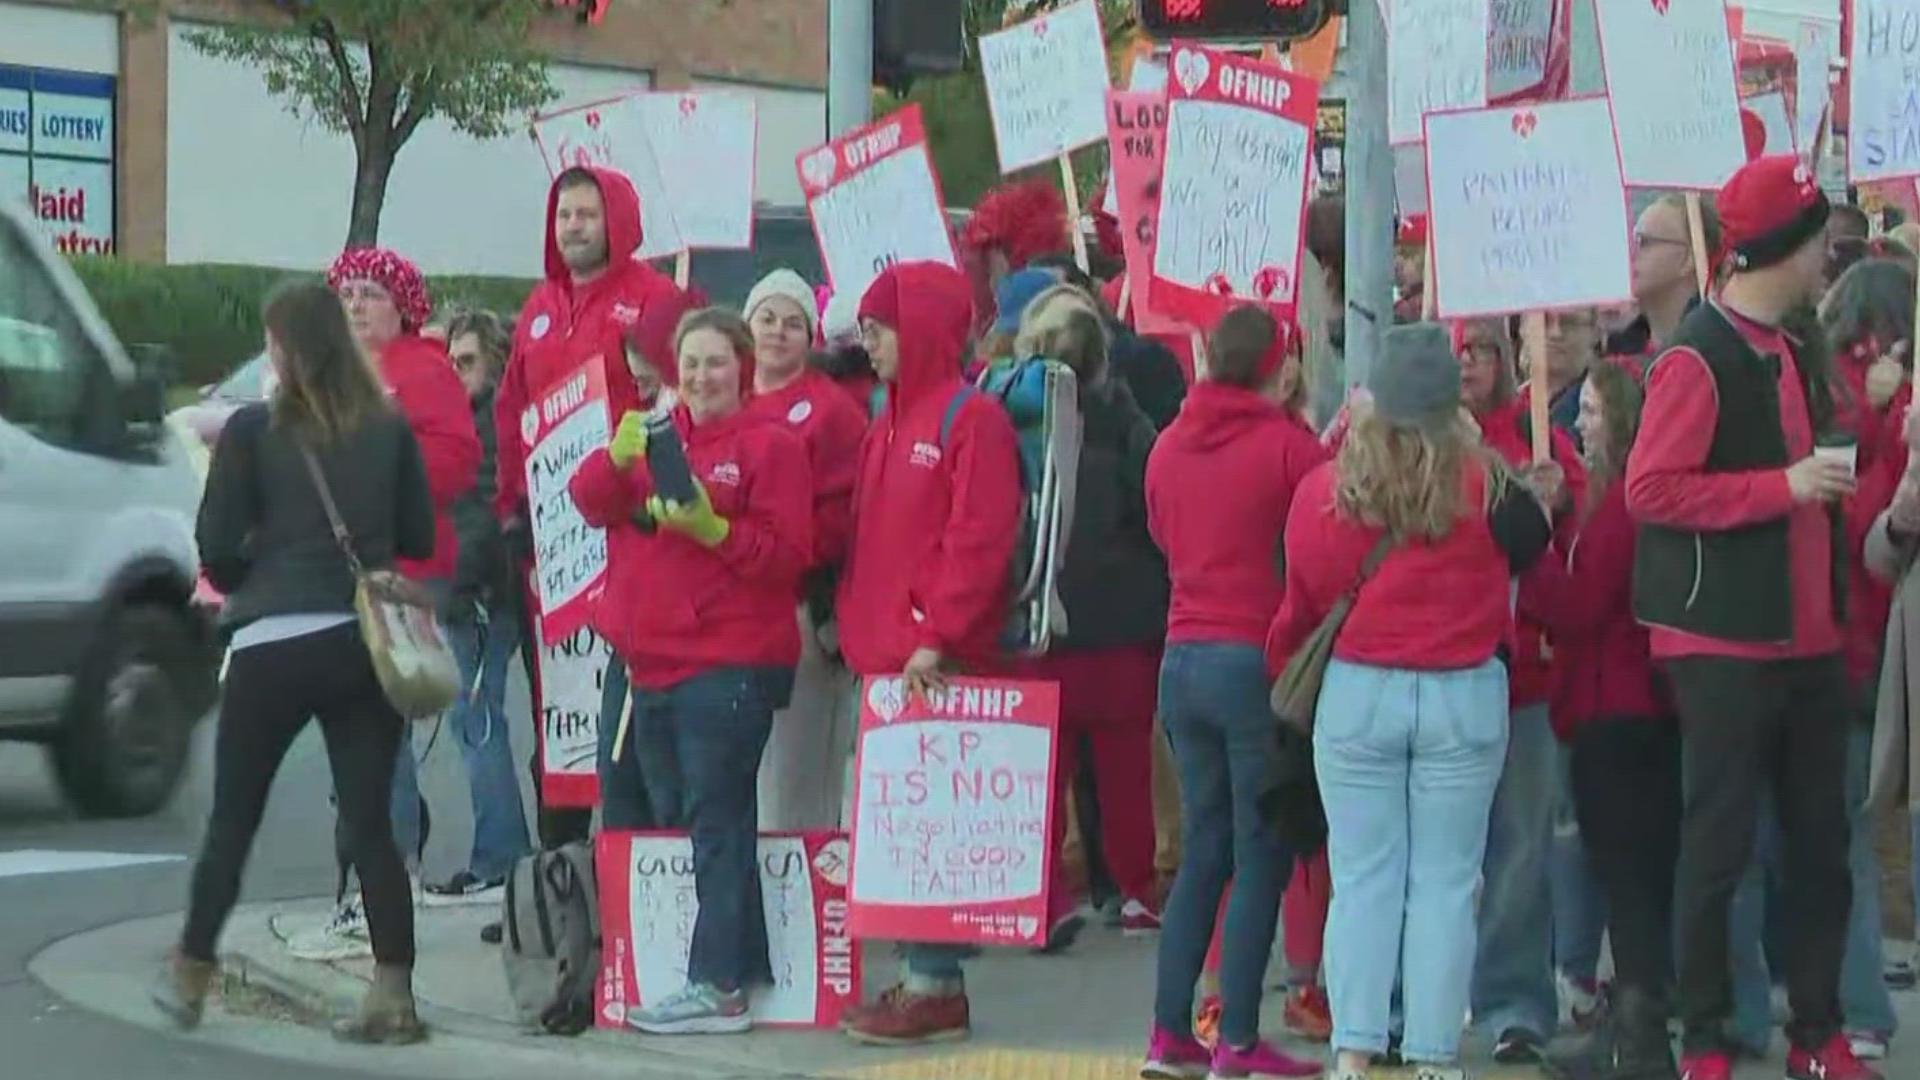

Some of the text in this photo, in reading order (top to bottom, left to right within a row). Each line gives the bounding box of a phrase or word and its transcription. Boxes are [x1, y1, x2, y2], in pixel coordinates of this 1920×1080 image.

[1218, 64, 1291, 112] OFNHP
[41, 112, 104, 141] LOTTERY
[1114, 102, 1165, 130] LOO
[538, 523, 589, 569] BETTE
[870, 766, 1043, 810] IS NOT
[944, 844, 1026, 869] GOOD
[911, 868, 1007, 898] FAITH
